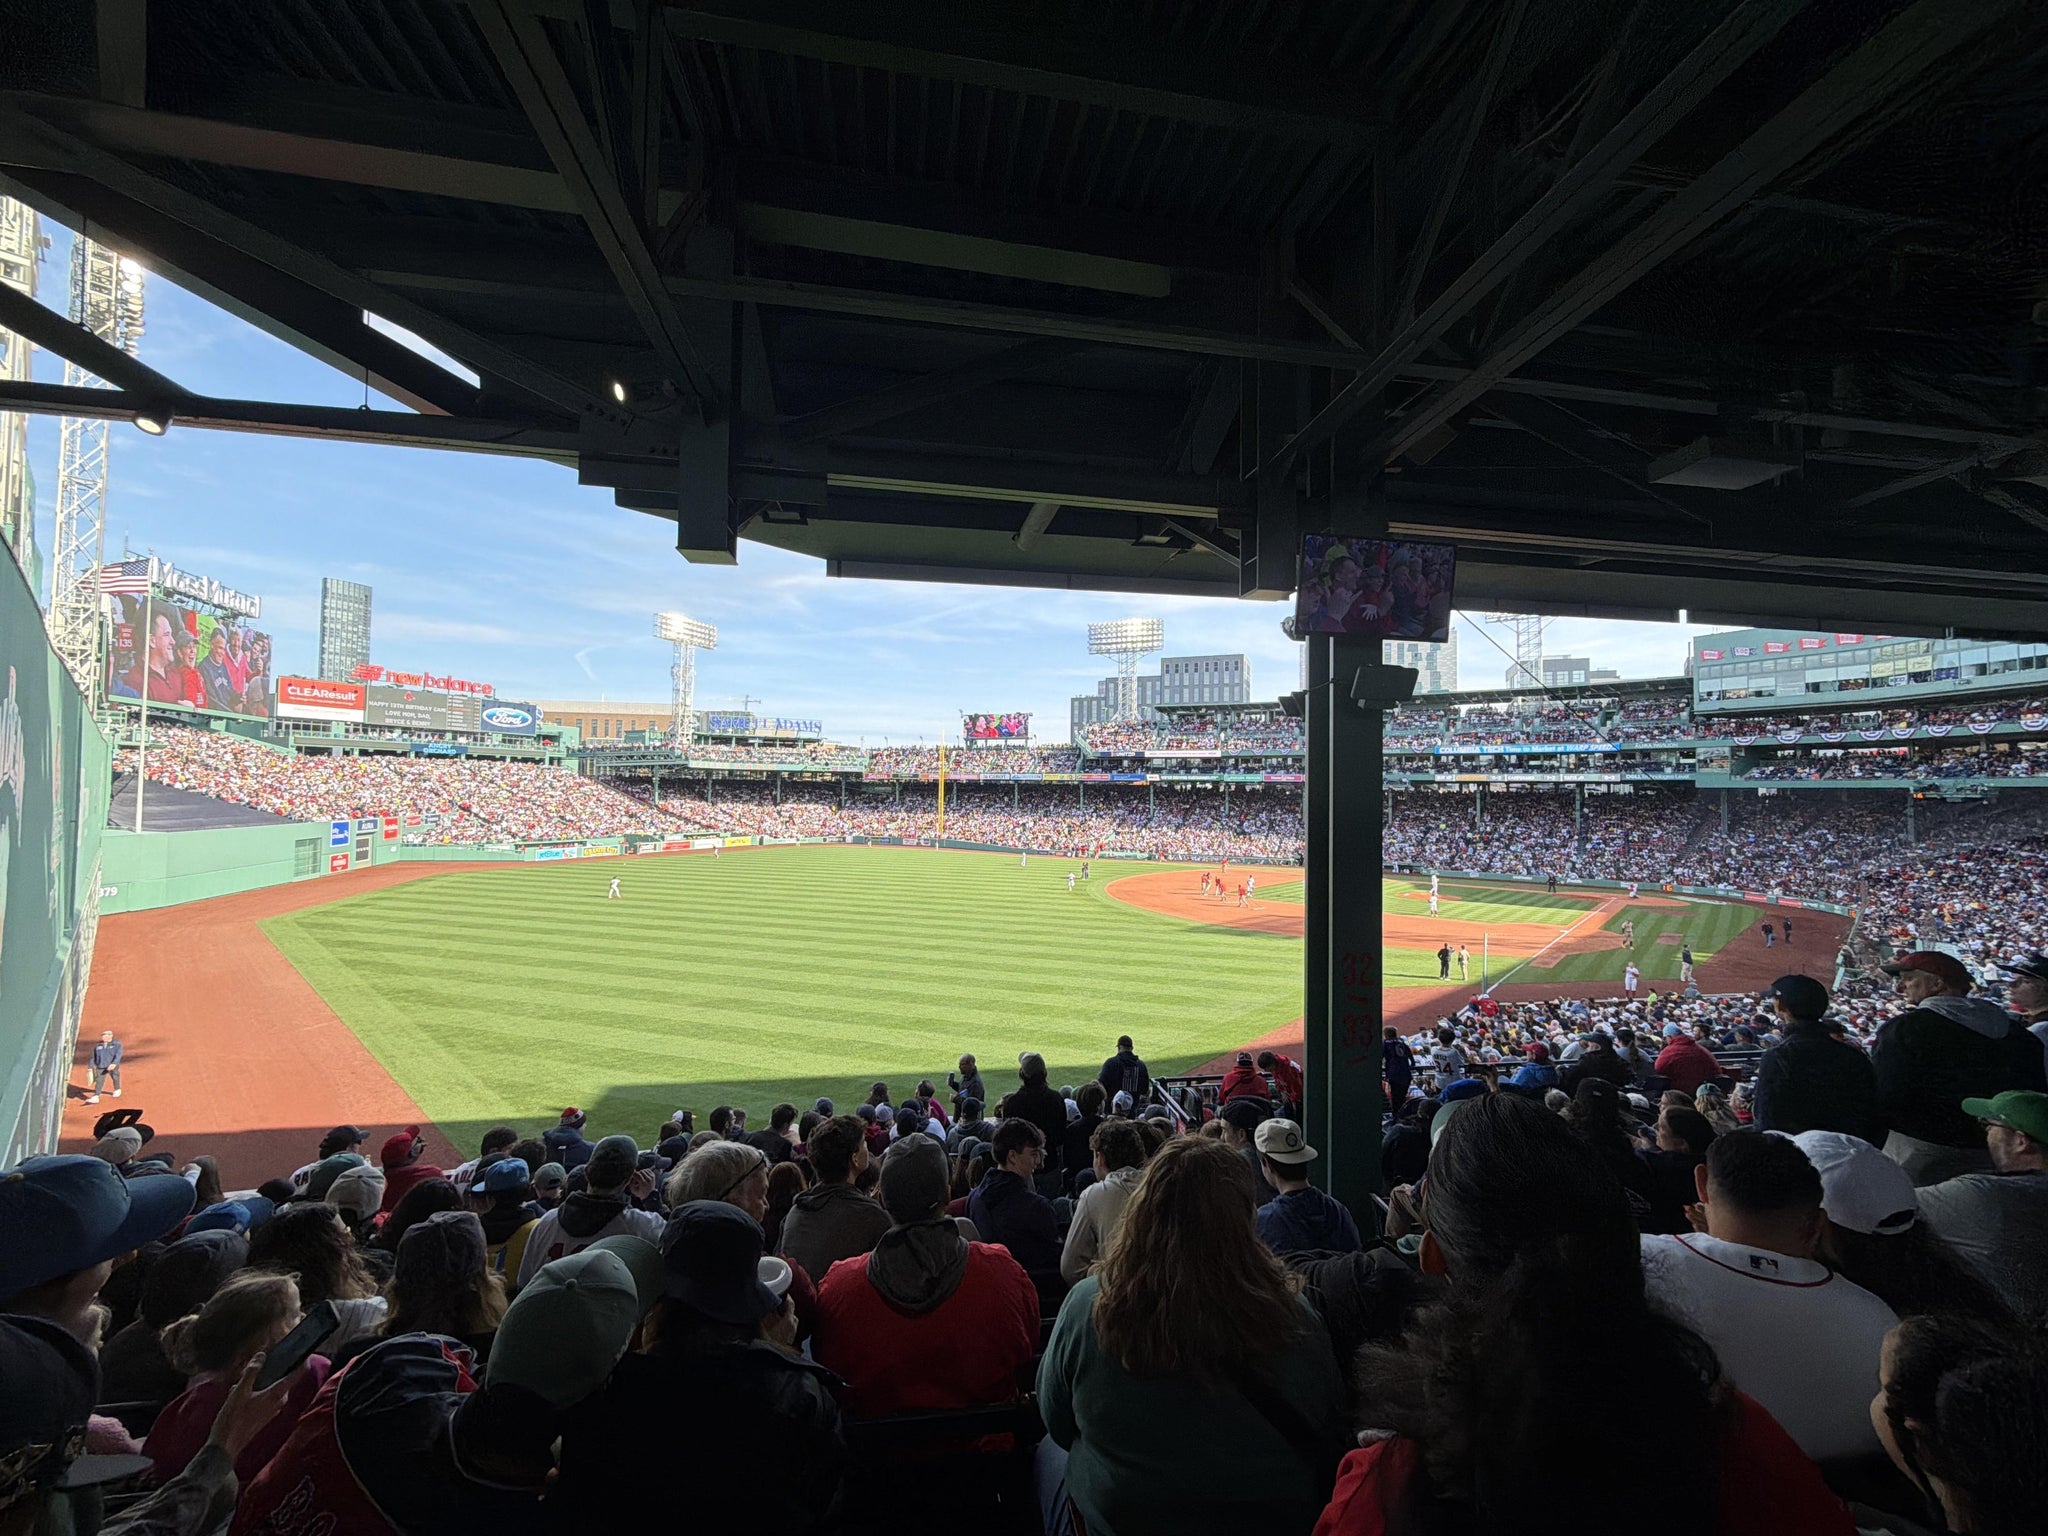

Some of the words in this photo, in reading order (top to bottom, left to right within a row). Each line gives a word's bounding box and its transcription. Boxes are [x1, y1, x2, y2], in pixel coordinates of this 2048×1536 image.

[149, 556, 261, 618] MassMutual
[386, 671, 423, 687] new
[424, 672, 493, 696] balance
[288, 686, 358, 702] CLEAResult
[369, 701, 389, 709] HAPPY
[405, 704, 432, 712] BIRTHDAY
[493, 711, 522, 726] Ford
[709, 715, 771, 731] SAMUEL
[775, 718, 822, 734] ADAMS
[539, 849, 561, 860] jetBlue
[98, 887, 118, 897] 379
[1344, 1013, 1374, 1049] 33
[1434, 1060, 1453, 1076] 34
